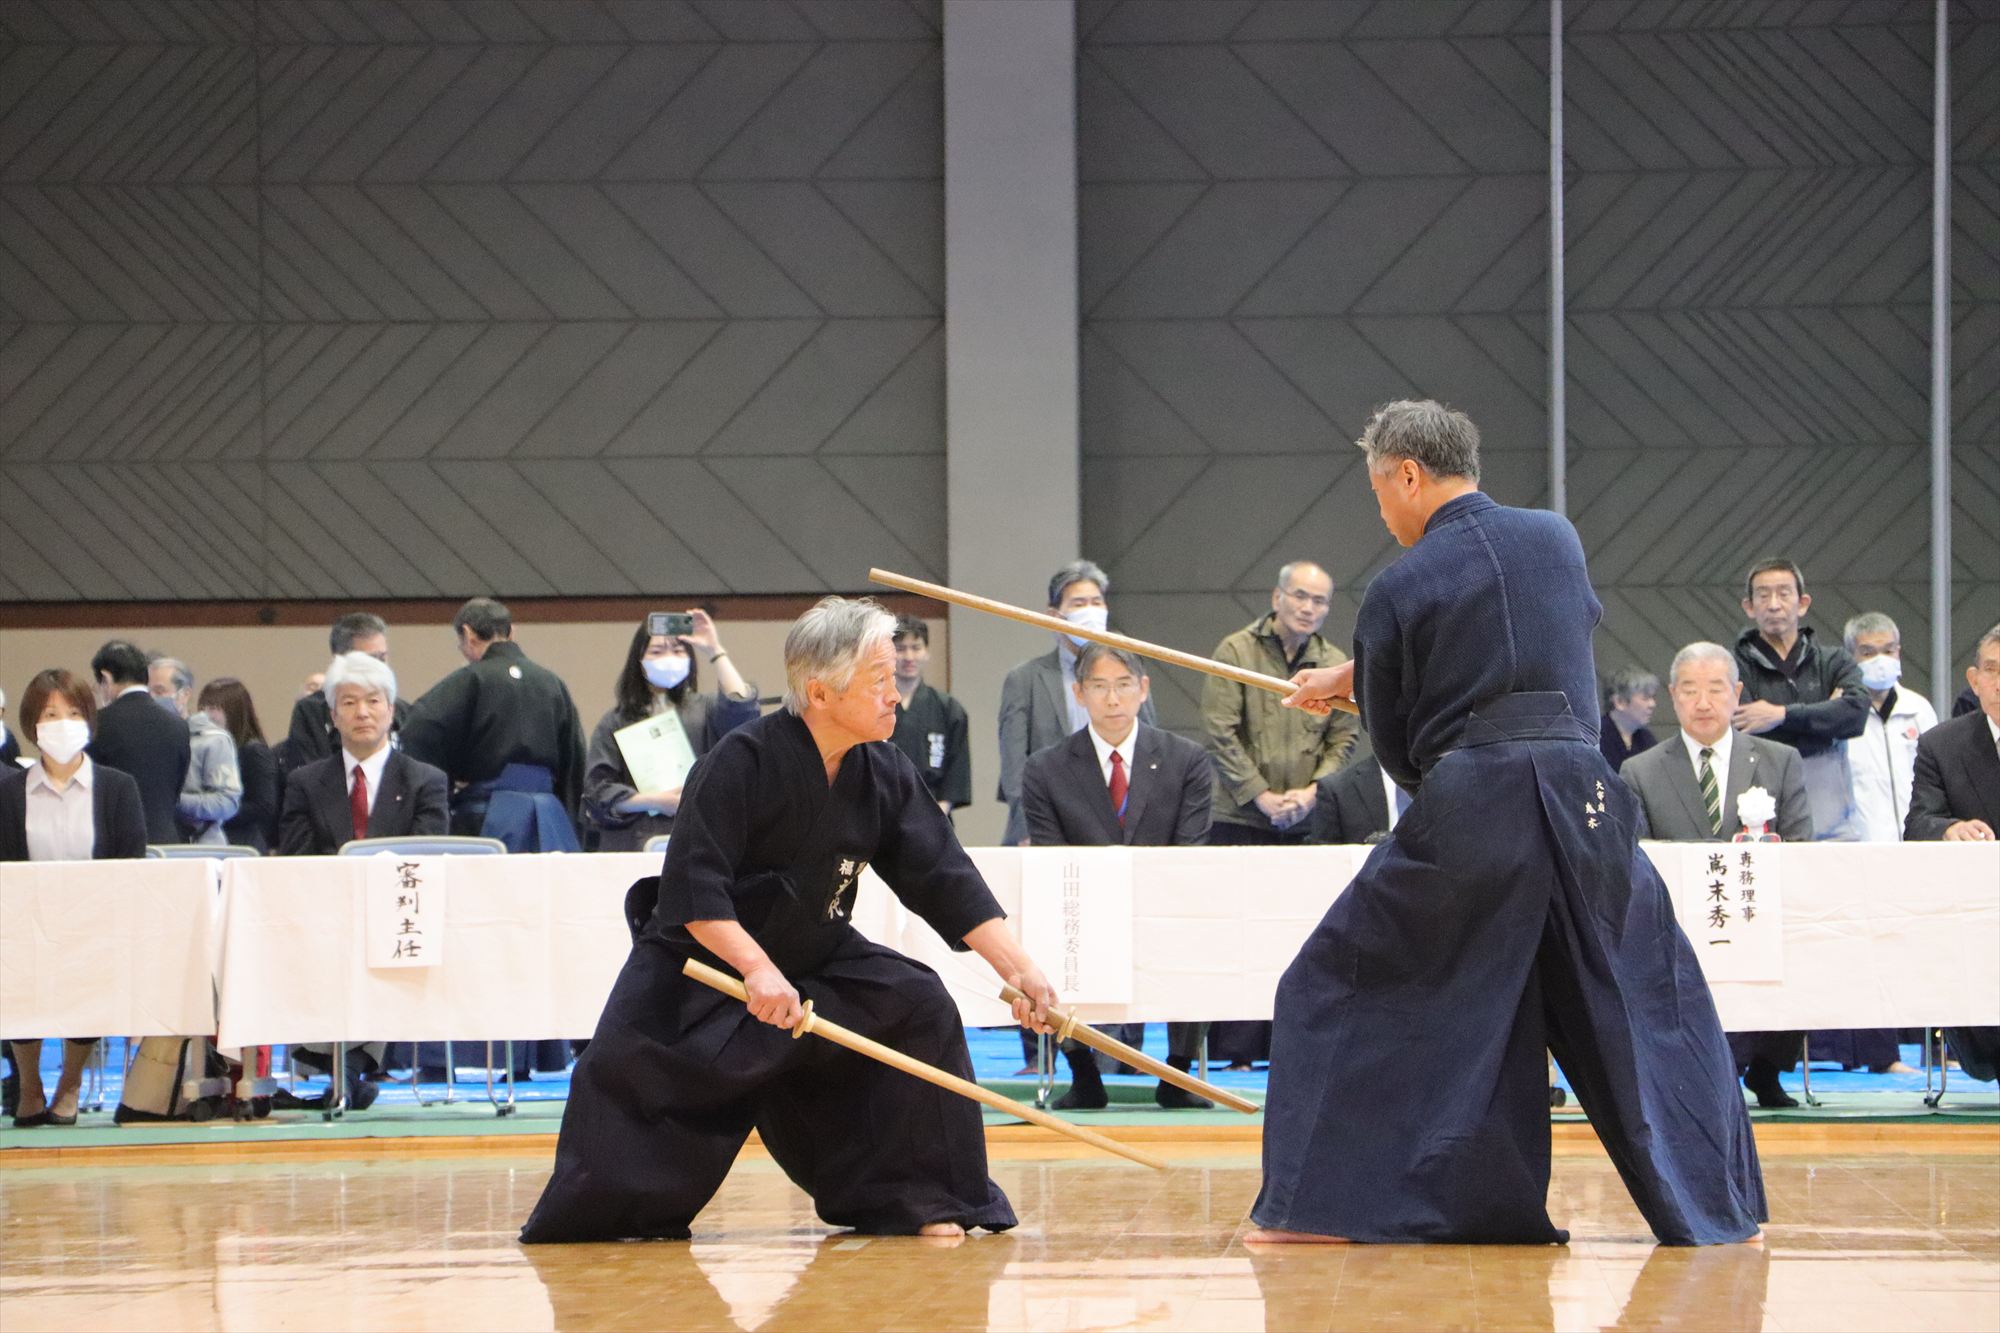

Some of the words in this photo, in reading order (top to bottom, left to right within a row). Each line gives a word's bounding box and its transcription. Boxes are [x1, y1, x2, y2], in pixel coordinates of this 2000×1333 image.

[393, 862, 423, 959] 審判主任
[1063, 862, 1080, 992] 山田総務委員長
[1739, 851, 1757, 922] 専務理事
